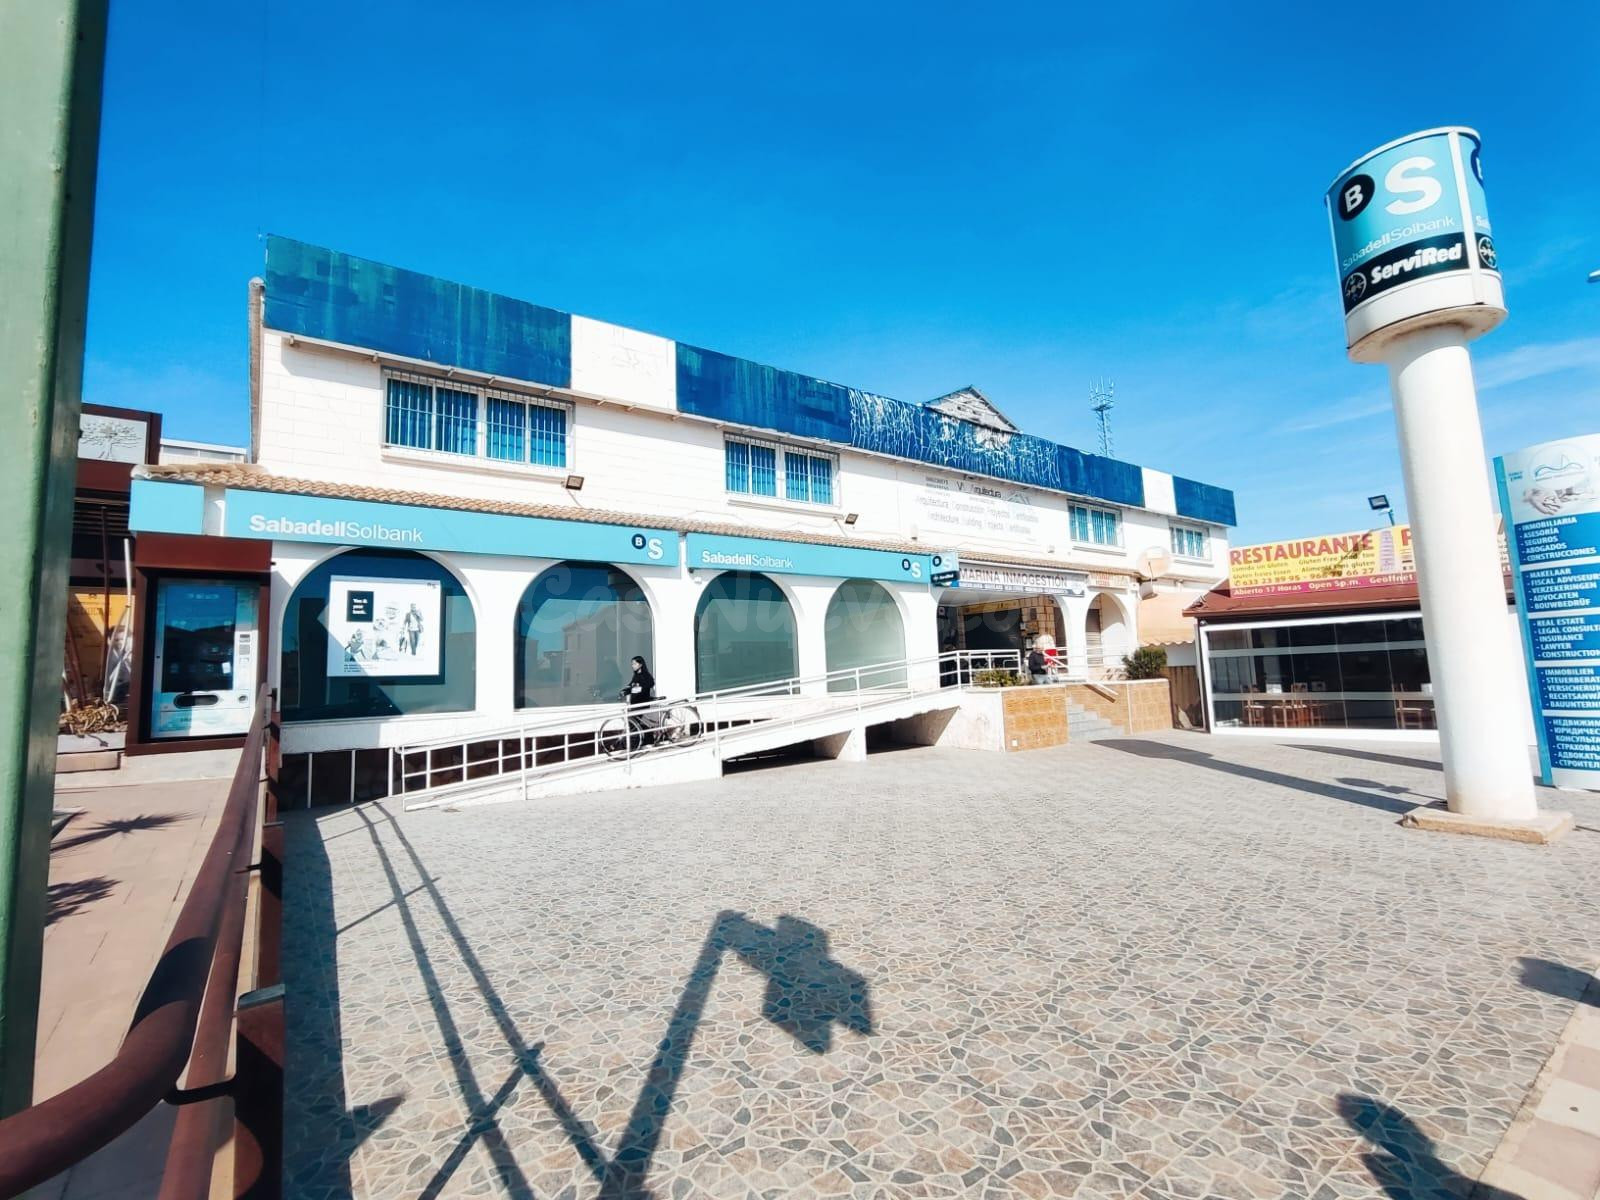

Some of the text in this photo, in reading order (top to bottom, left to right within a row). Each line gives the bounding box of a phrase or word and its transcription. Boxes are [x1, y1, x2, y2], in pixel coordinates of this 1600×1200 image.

[1344, 156, 1442, 216] B S
[1343, 216, 1456, 271] SabadellSolbank
[1371, 243, 1462, 284] ServiRed
[249, 514, 423, 543] SabadellSolbank
[1524, 535, 1558, 546] SEGUROS
[647, 538, 664, 560] S
[1230, 532, 1374, 566] RESTAURANTE
[1526, 542, 1567, 554] ABOGADOS
[1527, 547, 1597, 561] CONSTRUCCIONES
[702, 550, 794, 569] SabadellSolbank
[911, 562, 921, 578] S
[959, 567, 1001, 582] MARINA
[1530, 568, 1572, 578] MAKELAAR
[1309, 581, 1332, 591] Open
[1531, 577, 1555, 586] FISCAL
[1234, 587, 1263, 596] Abierto
[1277, 584, 1302, 592] Horas
[1533, 591, 1579, 602] ADVOCATEN
[1537, 617, 1585, 627] REAL ESTATE
[1538, 626, 1560, 635] LEGAL
[1540, 633, 1584, 643] INSURANCE
[1541, 642, 1572, 650] LAWYER
[1545, 668, 1594, 676] IMMOBILIEN
